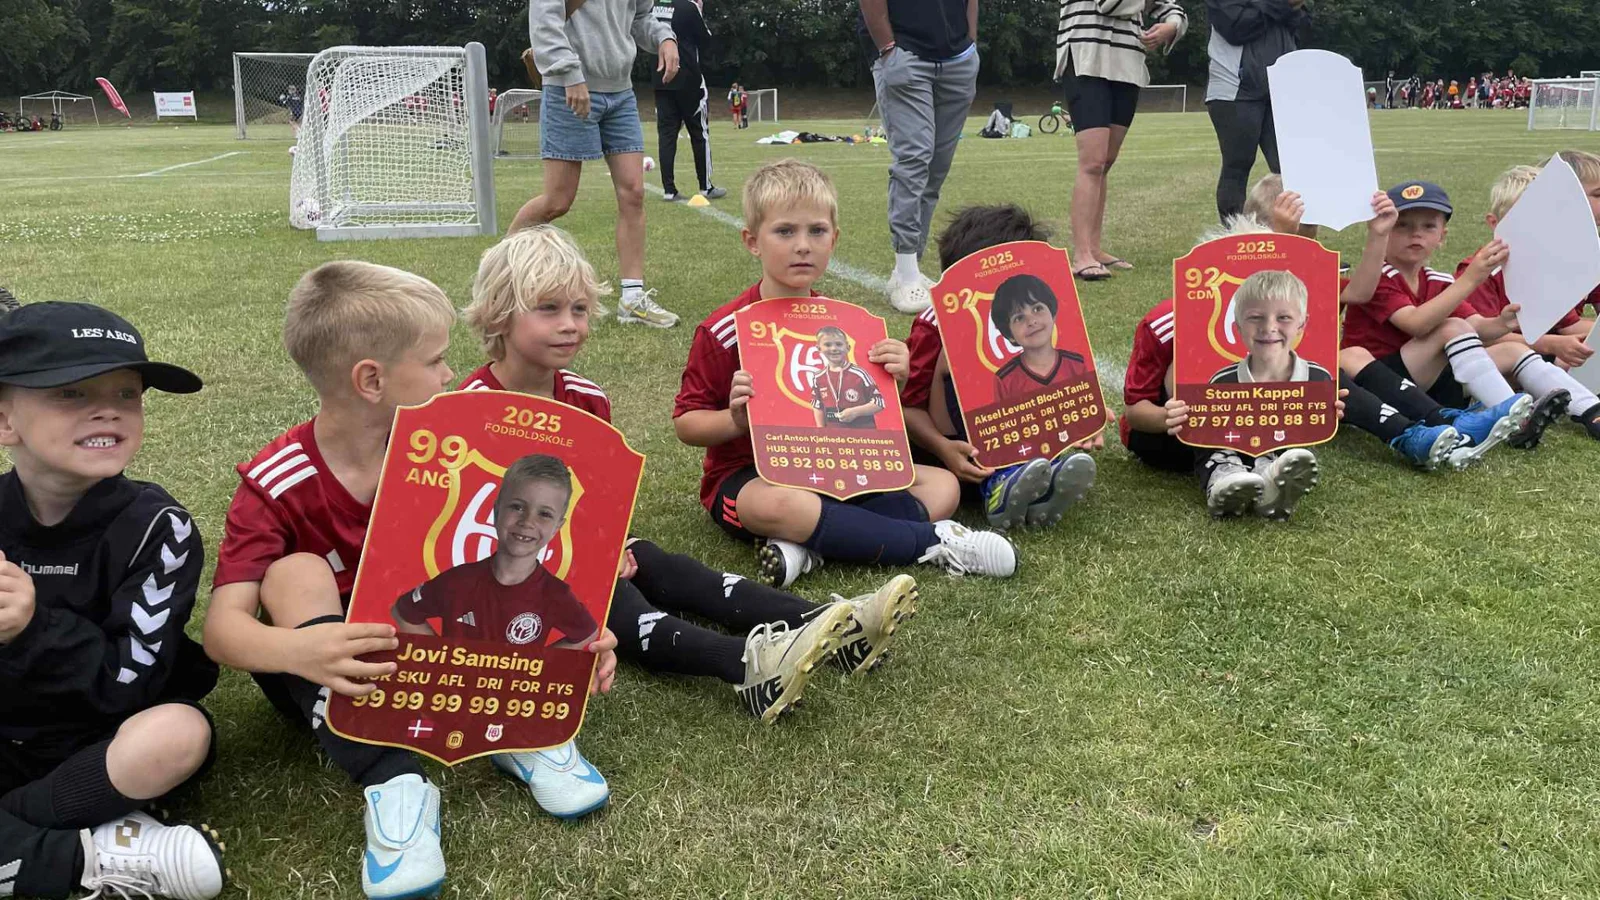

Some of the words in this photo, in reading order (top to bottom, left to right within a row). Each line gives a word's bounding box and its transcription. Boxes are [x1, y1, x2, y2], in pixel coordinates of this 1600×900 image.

[1237, 241, 1276, 253] 2025
[979, 251, 1014, 270] 2025
[1184, 266, 1220, 289] 92
[791, 303, 828, 314] 2025
[943, 287, 974, 314] 92
[106, 329, 137, 344] ARCS
[750, 321, 779, 339] 91
[1206, 389, 1249, 400] Storm
[1253, 386, 1304, 400] Kappel
[974, 409, 1001, 425] Aksel
[1003, 400, 1036, 416] Levent
[1037, 389, 1063, 405] Bloch
[1064, 381, 1089, 396] Tanis
[1188, 404, 1207, 412] HUR
[1308, 402, 1326, 410] FYS
[503, 405, 562, 433] 2025
[979, 426, 997, 437] HUR
[1000, 419, 1017, 431] SKU
[1021, 413, 1036, 424] AFL
[1041, 407, 1055, 417] DRI
[1059, 400, 1076, 411] FOR
[1079, 393, 1094, 404] FYS
[1189, 417, 1206, 427] 87
[1212, 416, 1230, 427] 97
[1235, 415, 1254, 426] 86
[1259, 415, 1278, 426] 80
[1284, 414, 1302, 425] 88
[1310, 414, 1326, 425] 91
[484, 422, 574, 448] FODBOLDSKOLE
[984, 438, 1000, 452] 72
[1003, 431, 1019, 445] 89
[1023, 424, 1039, 438] 99
[1045, 418, 1058, 431] 81
[1062, 411, 1079, 425] 96
[1081, 405, 1098, 419] 90
[406, 429, 468, 469] 99
[847, 437, 894, 445] Christensen
[766, 445, 788, 453] HUR
[790, 446, 810, 454] SKU
[815, 447, 833, 455] AFL
[883, 449, 900, 457] FYS
[770, 456, 789, 467] 89
[793, 457, 812, 468] 92
[816, 458, 835, 469] 80
[840, 459, 858, 470] 84
[863, 460, 881, 470] 98
[885, 461, 904, 471] 90
[405, 468, 453, 488] ANG
[21, 561, 79, 576] hummel
[397, 643, 448, 665] Jovi
[450, 648, 544, 677] Samsing
[396, 670, 431, 685] SKU
[437, 674, 465, 688] AFL
[476, 676, 502, 690] DRI
[510, 679, 540, 693] FOR
[546, 682, 574, 696] FYS
[392, 692, 424, 710] 99
[431, 694, 462, 713] 99
[469, 697, 499, 715] 99
[506, 700, 535, 718] 99
[541, 702, 569, 720] 99
